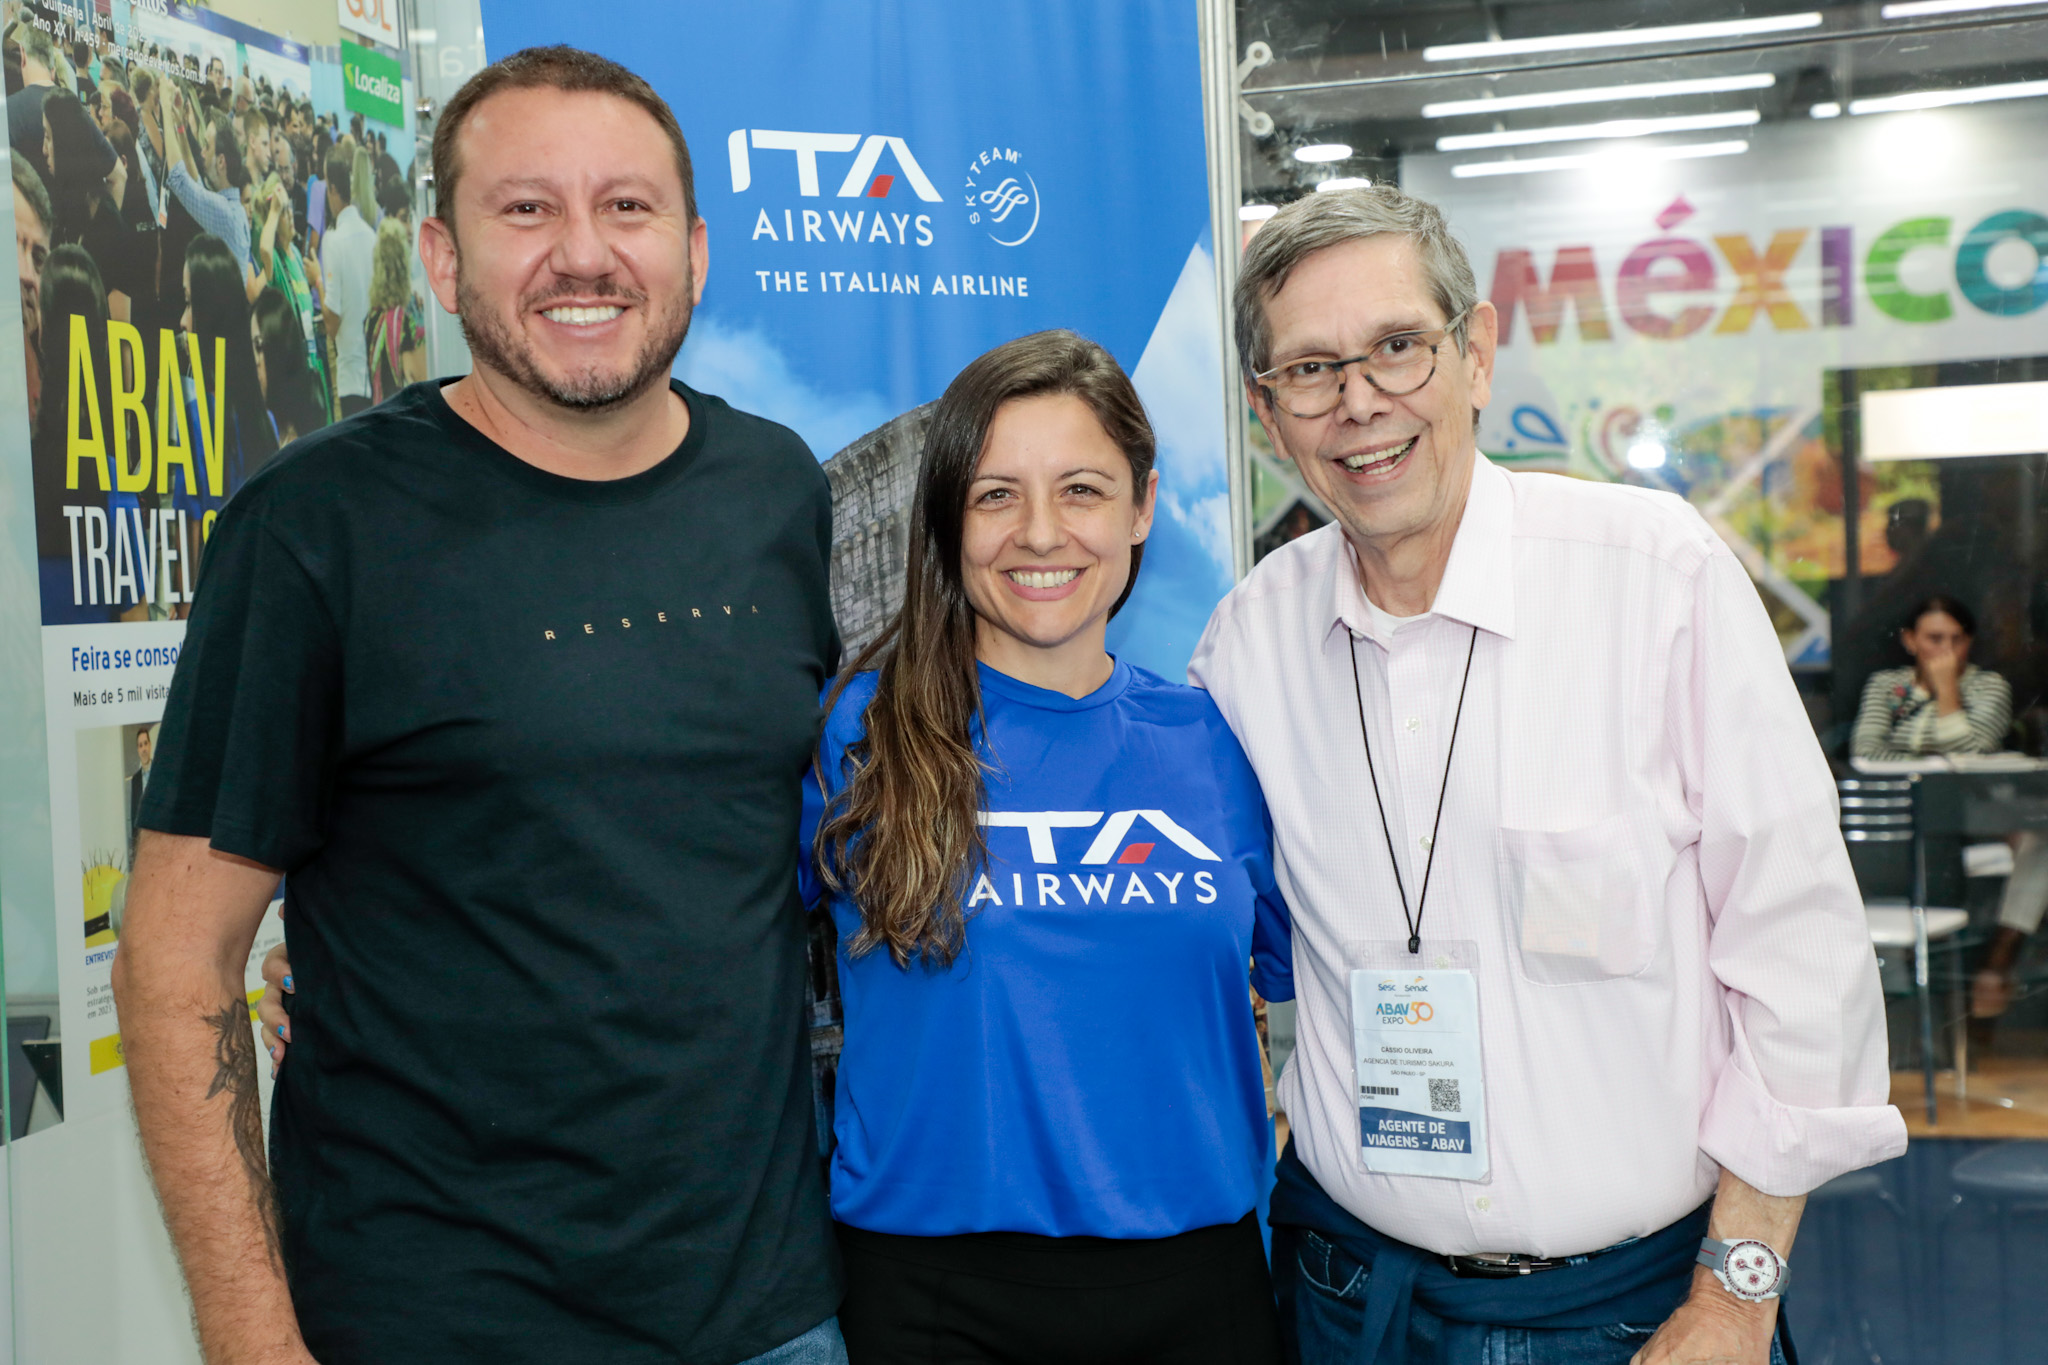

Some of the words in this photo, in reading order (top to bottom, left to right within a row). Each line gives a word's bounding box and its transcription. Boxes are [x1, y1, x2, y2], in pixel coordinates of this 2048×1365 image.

[32, 13, 51, 33] Ano
[53, 20, 67, 39] XX
[91, 12, 113, 31] Abril
[114, 20, 126, 36] de
[353, 65, 401, 105] Localiza
[728, 128, 944, 203] ITA
[751, 208, 934, 247] AIRWAYS
[755, 270, 809, 292] THE
[820, 271, 921, 295] ITALIAN
[931, 274, 1029, 297] AIRLINE
[66, 313, 226, 497] ABAV
[63, 505, 196, 606] TRAVEL
[544, 604, 759, 641] RESERVA
[72, 645, 110, 672] Feira
[114, 649, 132, 669] se
[73, 690, 97, 707] Mais
[101, 689, 113, 704] de
[117, 688, 124, 703] 5
[127, 686, 142, 702] mil
[967, 871, 1218, 908] AIRWAYS
[1378, 984, 1396, 992] Sesc
[1404, 984, 1428, 992] Senac
[1382, 1016, 1404, 1025] EXPO
[1404, 1047, 1433, 1055] OLIVEIRA
[1378, 1119, 1426, 1133] AGENTE
[1429, 1121, 1446, 1134] DE
[1366, 1133, 1420, 1148] VIAGENS
[1431, 1137, 1465, 1151] ABAV
